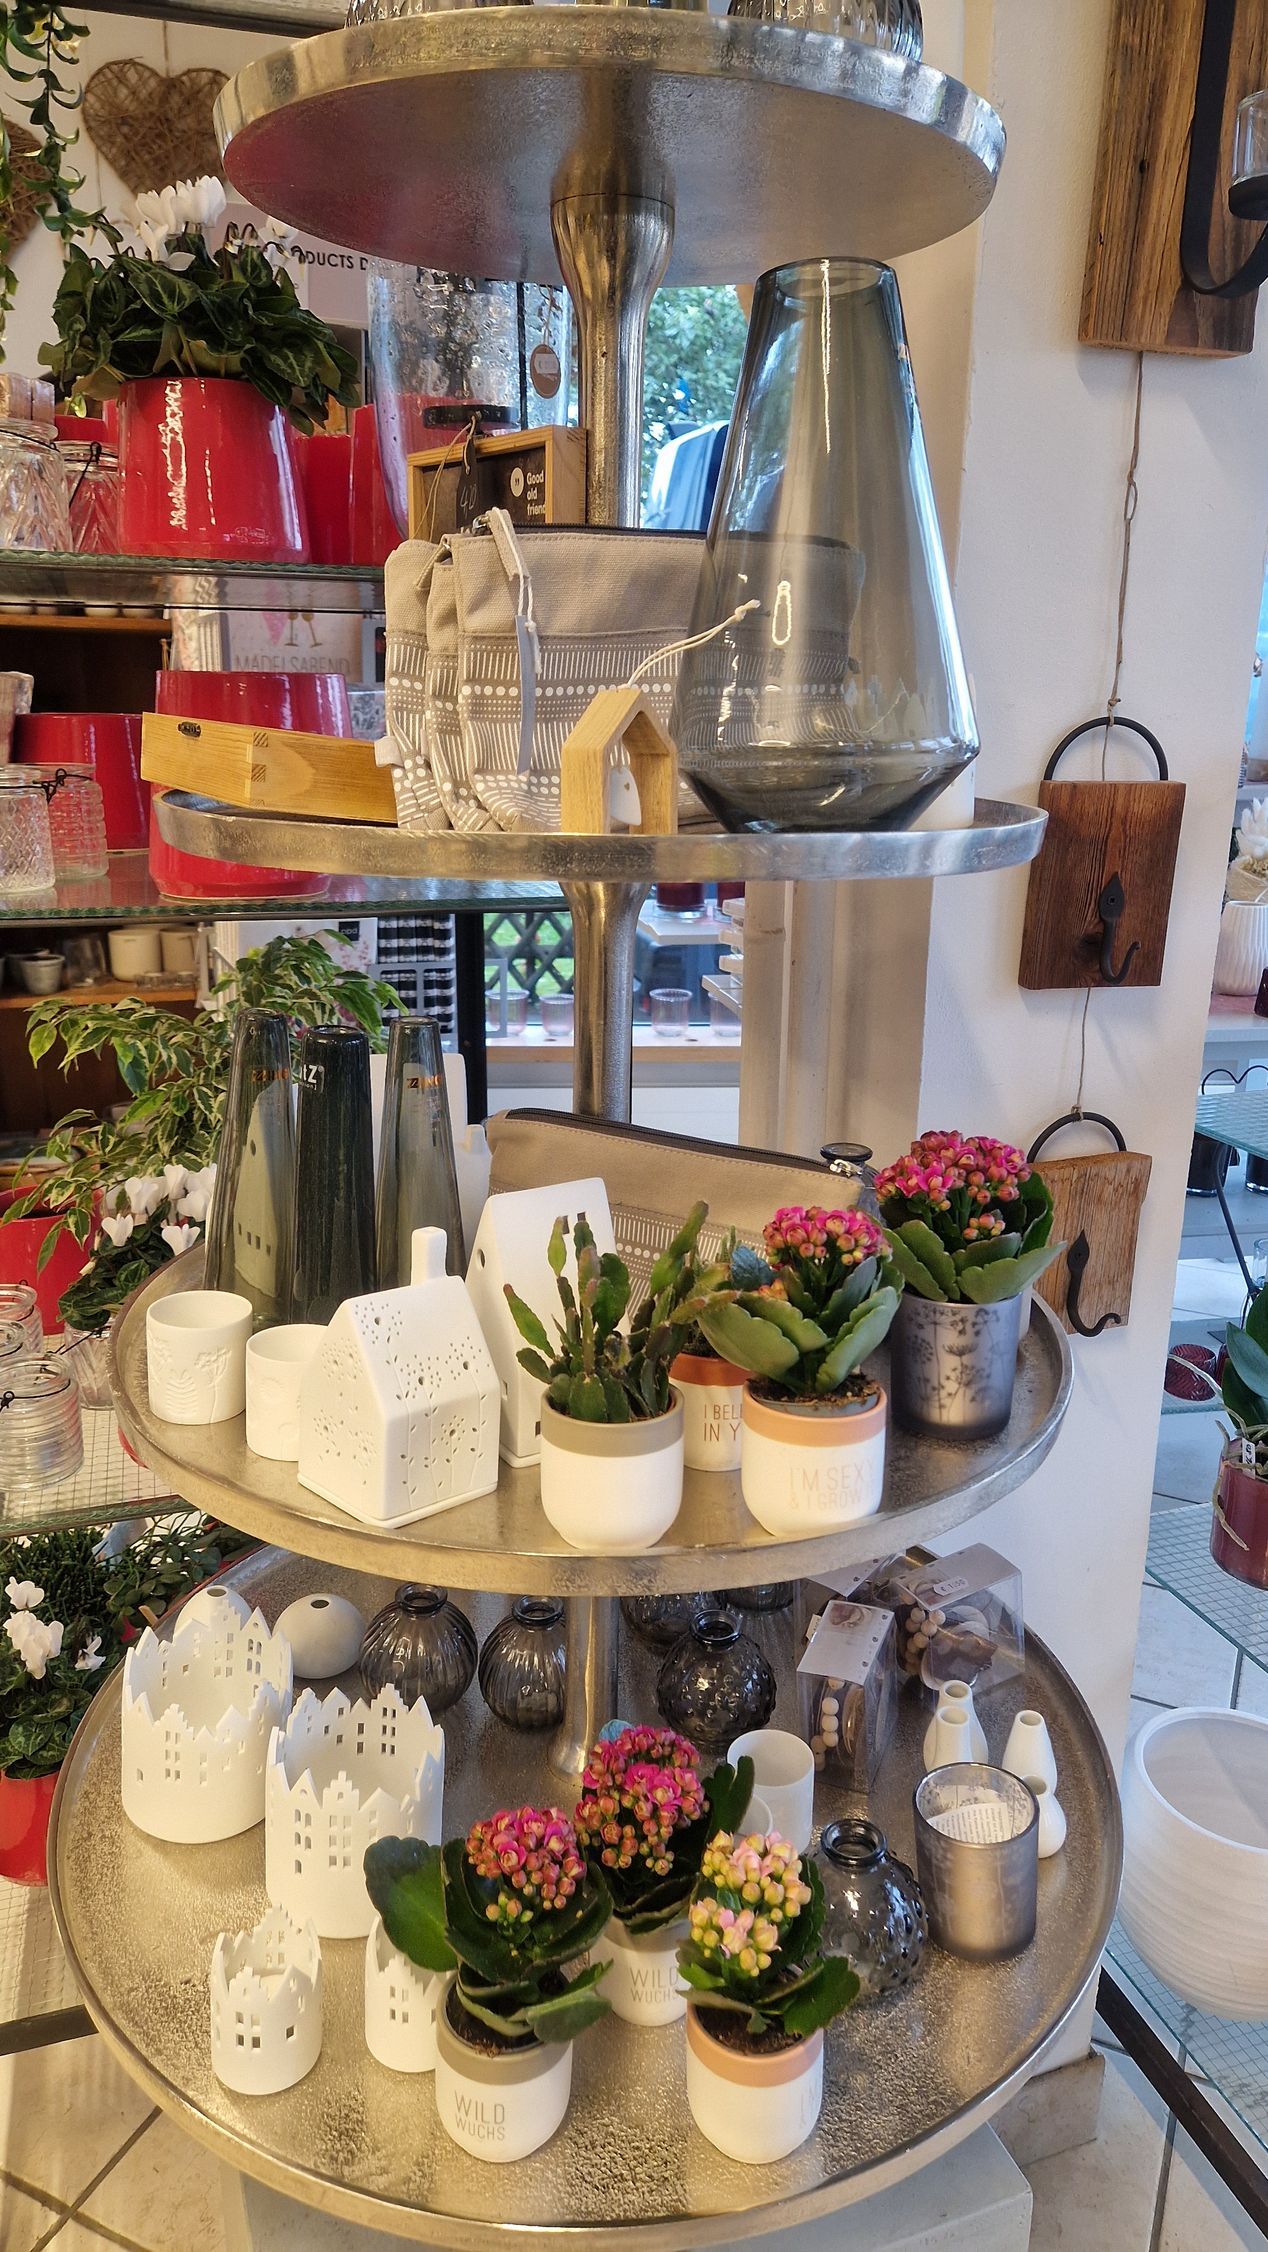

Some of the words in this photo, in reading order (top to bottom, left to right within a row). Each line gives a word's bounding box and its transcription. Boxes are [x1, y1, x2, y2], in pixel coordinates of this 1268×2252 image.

[305, 251, 354, 269] DUCTS
[527, 470, 544, 485] Good
[527, 487, 538, 500] old
[703, 1422, 720, 1442] IN
[789, 1466, 819, 1491] I'M
[826, 1457, 873, 1491] SEXY
[817, 1487, 862, 1511] GROW
[629, 1966, 678, 1989] WILD
[454, 2089, 505, 2125] WILD
[455, 2112, 505, 2142] WUCHS
